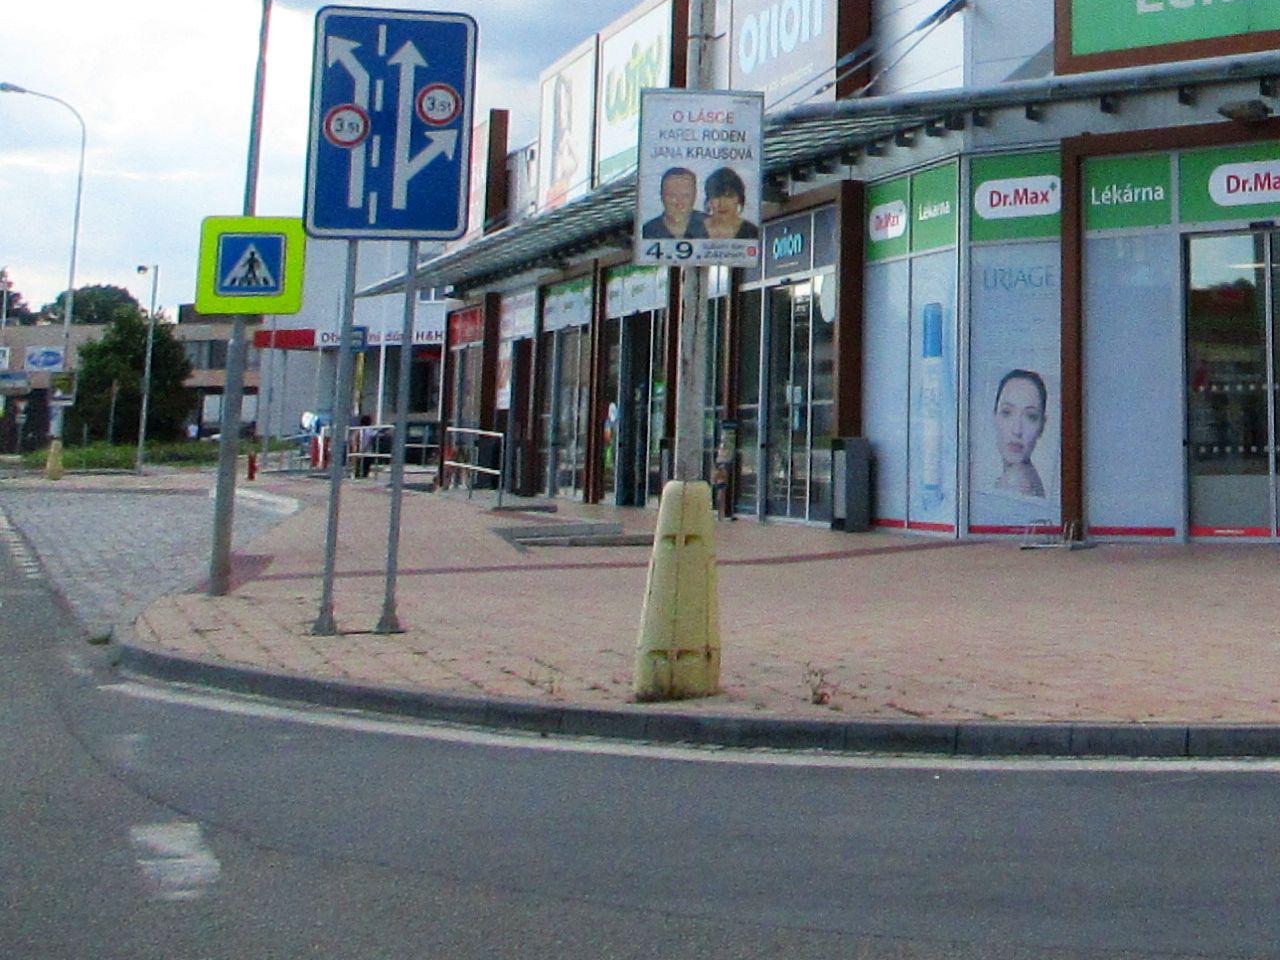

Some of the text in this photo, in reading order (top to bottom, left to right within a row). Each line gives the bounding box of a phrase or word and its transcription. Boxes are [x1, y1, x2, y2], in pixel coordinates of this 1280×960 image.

[672, 107, 735, 125] O LÁSCE
[658, 128, 747, 143] KAREL RODEN
[650, 145, 753, 161] JANA KRAUSOVÁ
[989, 187, 1050, 208] Dr.Max
[1091, 181, 1165, 206] Lékárna
[983, 266, 1054, 291] URIAGE
